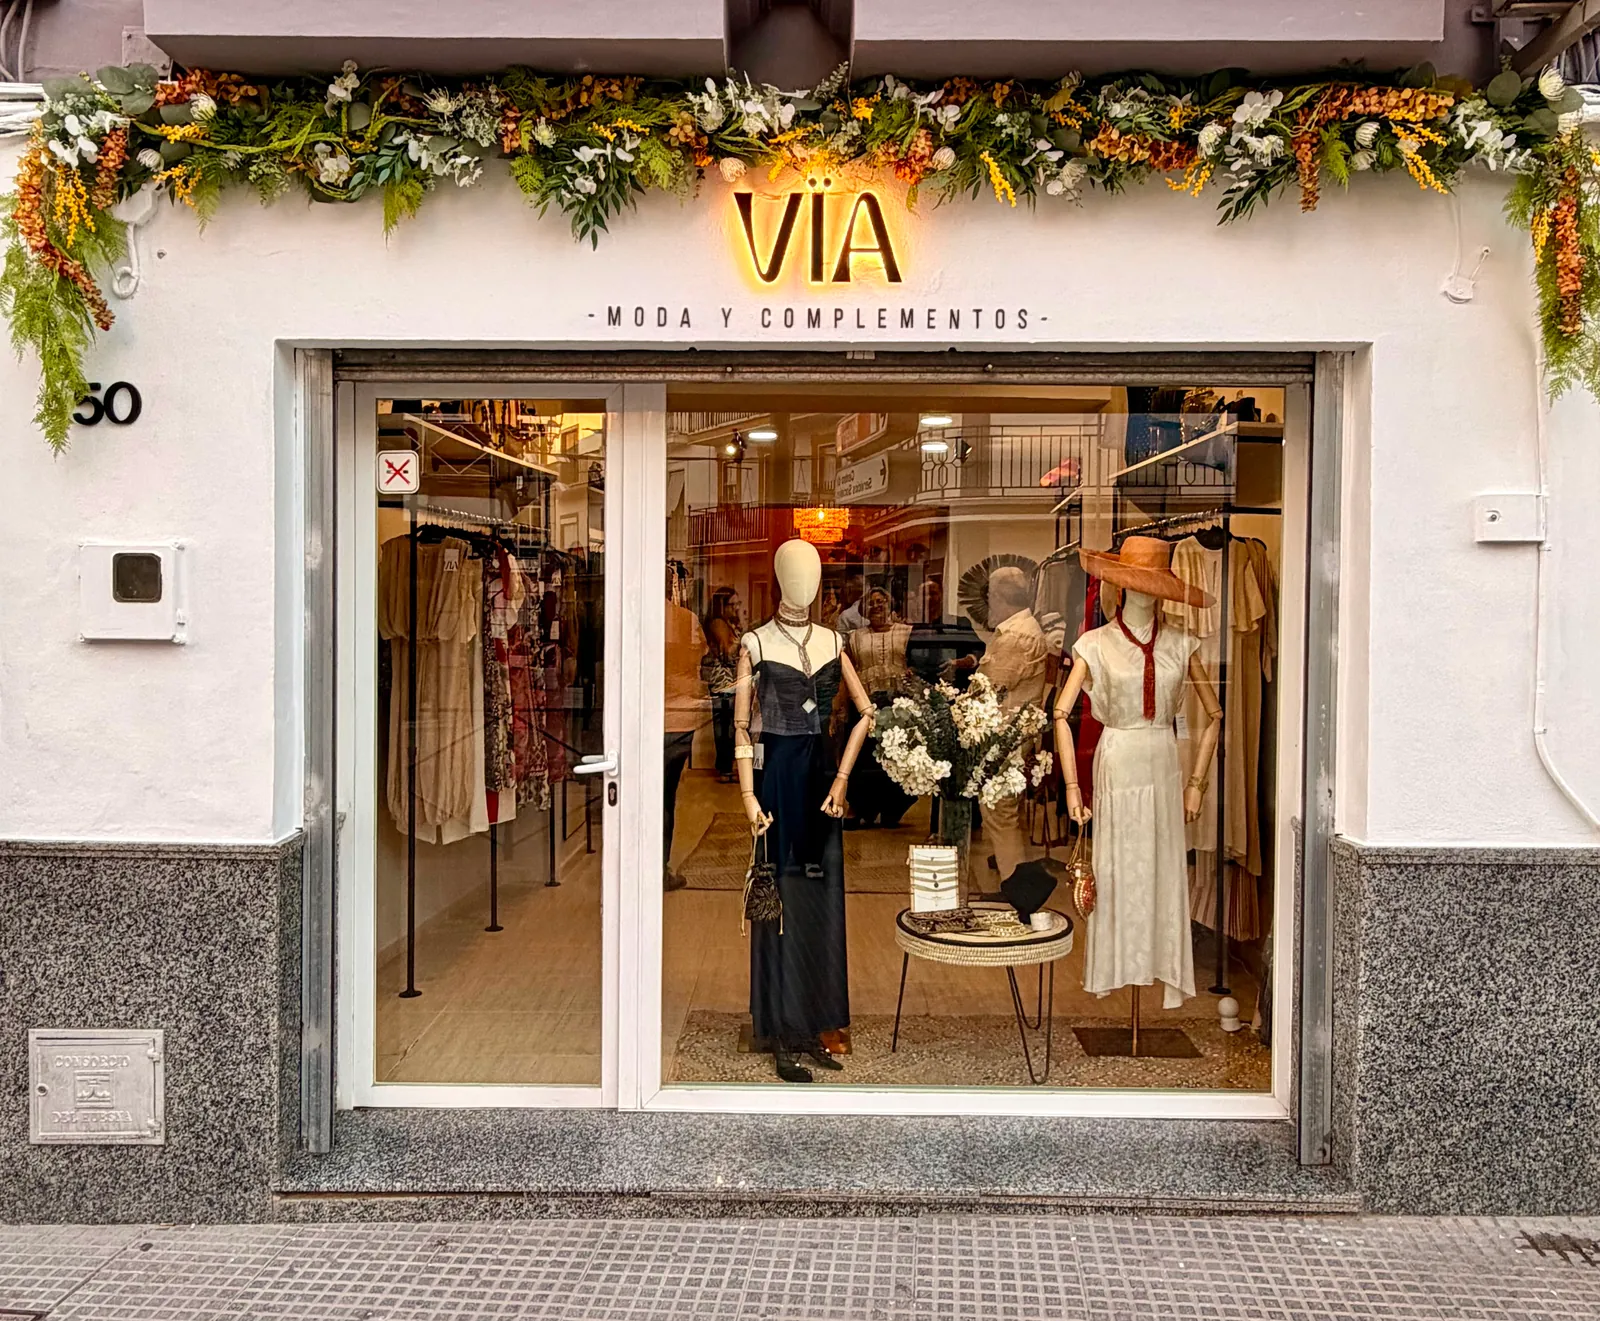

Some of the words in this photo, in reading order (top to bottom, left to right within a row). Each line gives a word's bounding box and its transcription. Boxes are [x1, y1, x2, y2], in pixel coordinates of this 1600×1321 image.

[734, 177, 902, 283] VÏA
[721, 307, 733, 328] Y
[73, 381, 142, 426] 50
